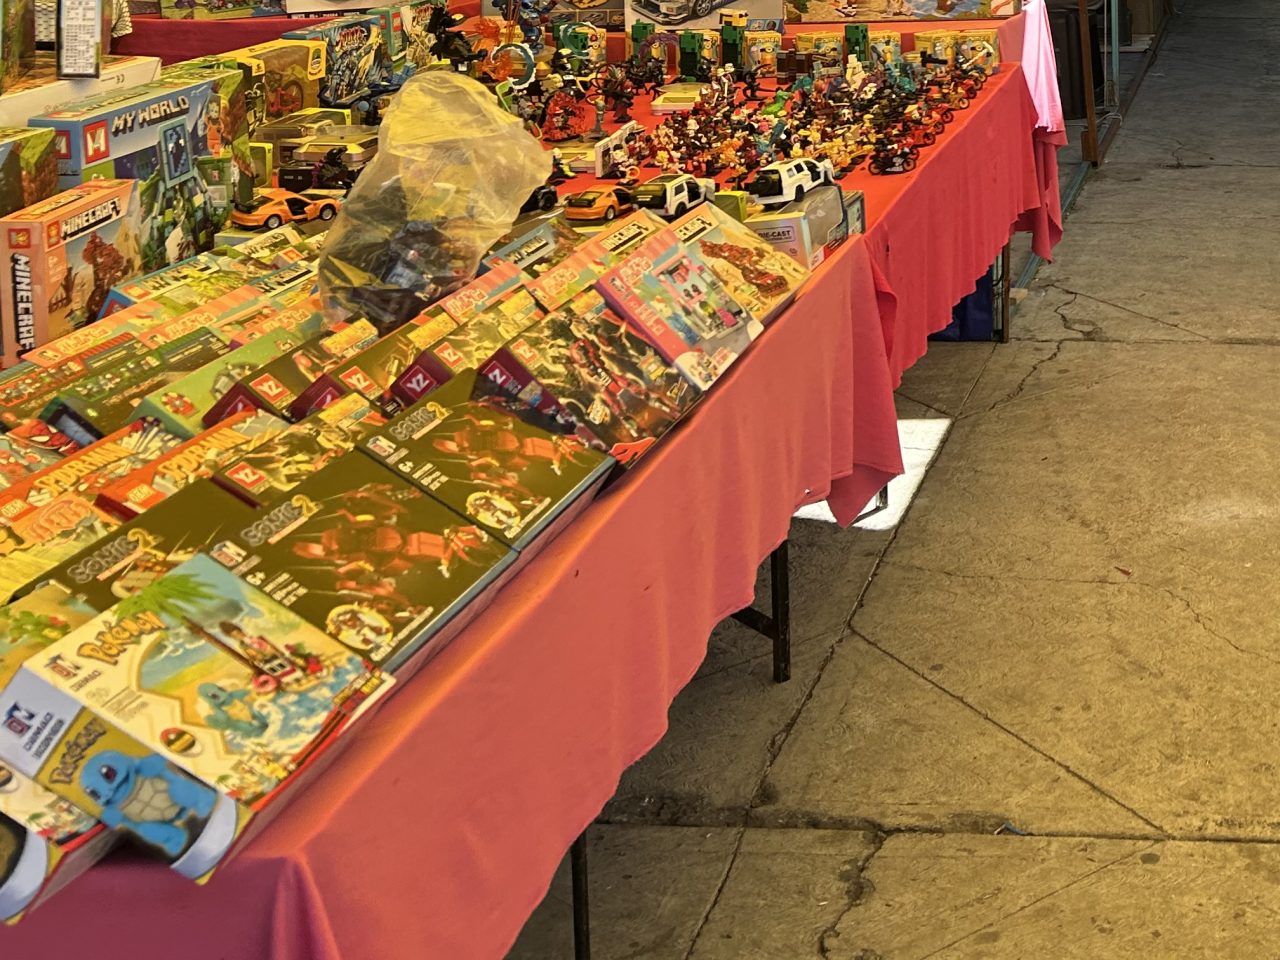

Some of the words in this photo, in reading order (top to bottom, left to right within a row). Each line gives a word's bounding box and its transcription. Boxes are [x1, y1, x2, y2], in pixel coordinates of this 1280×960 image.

[138, 95, 191, 123] WORLD
[61, 197, 122, 238] MINECRAFT
[13, 253, 36, 356] MINECRAF
[258, 379, 281, 398] YZ
[348, 373, 371, 391] YZ
[406, 373, 431, 392] YZ
